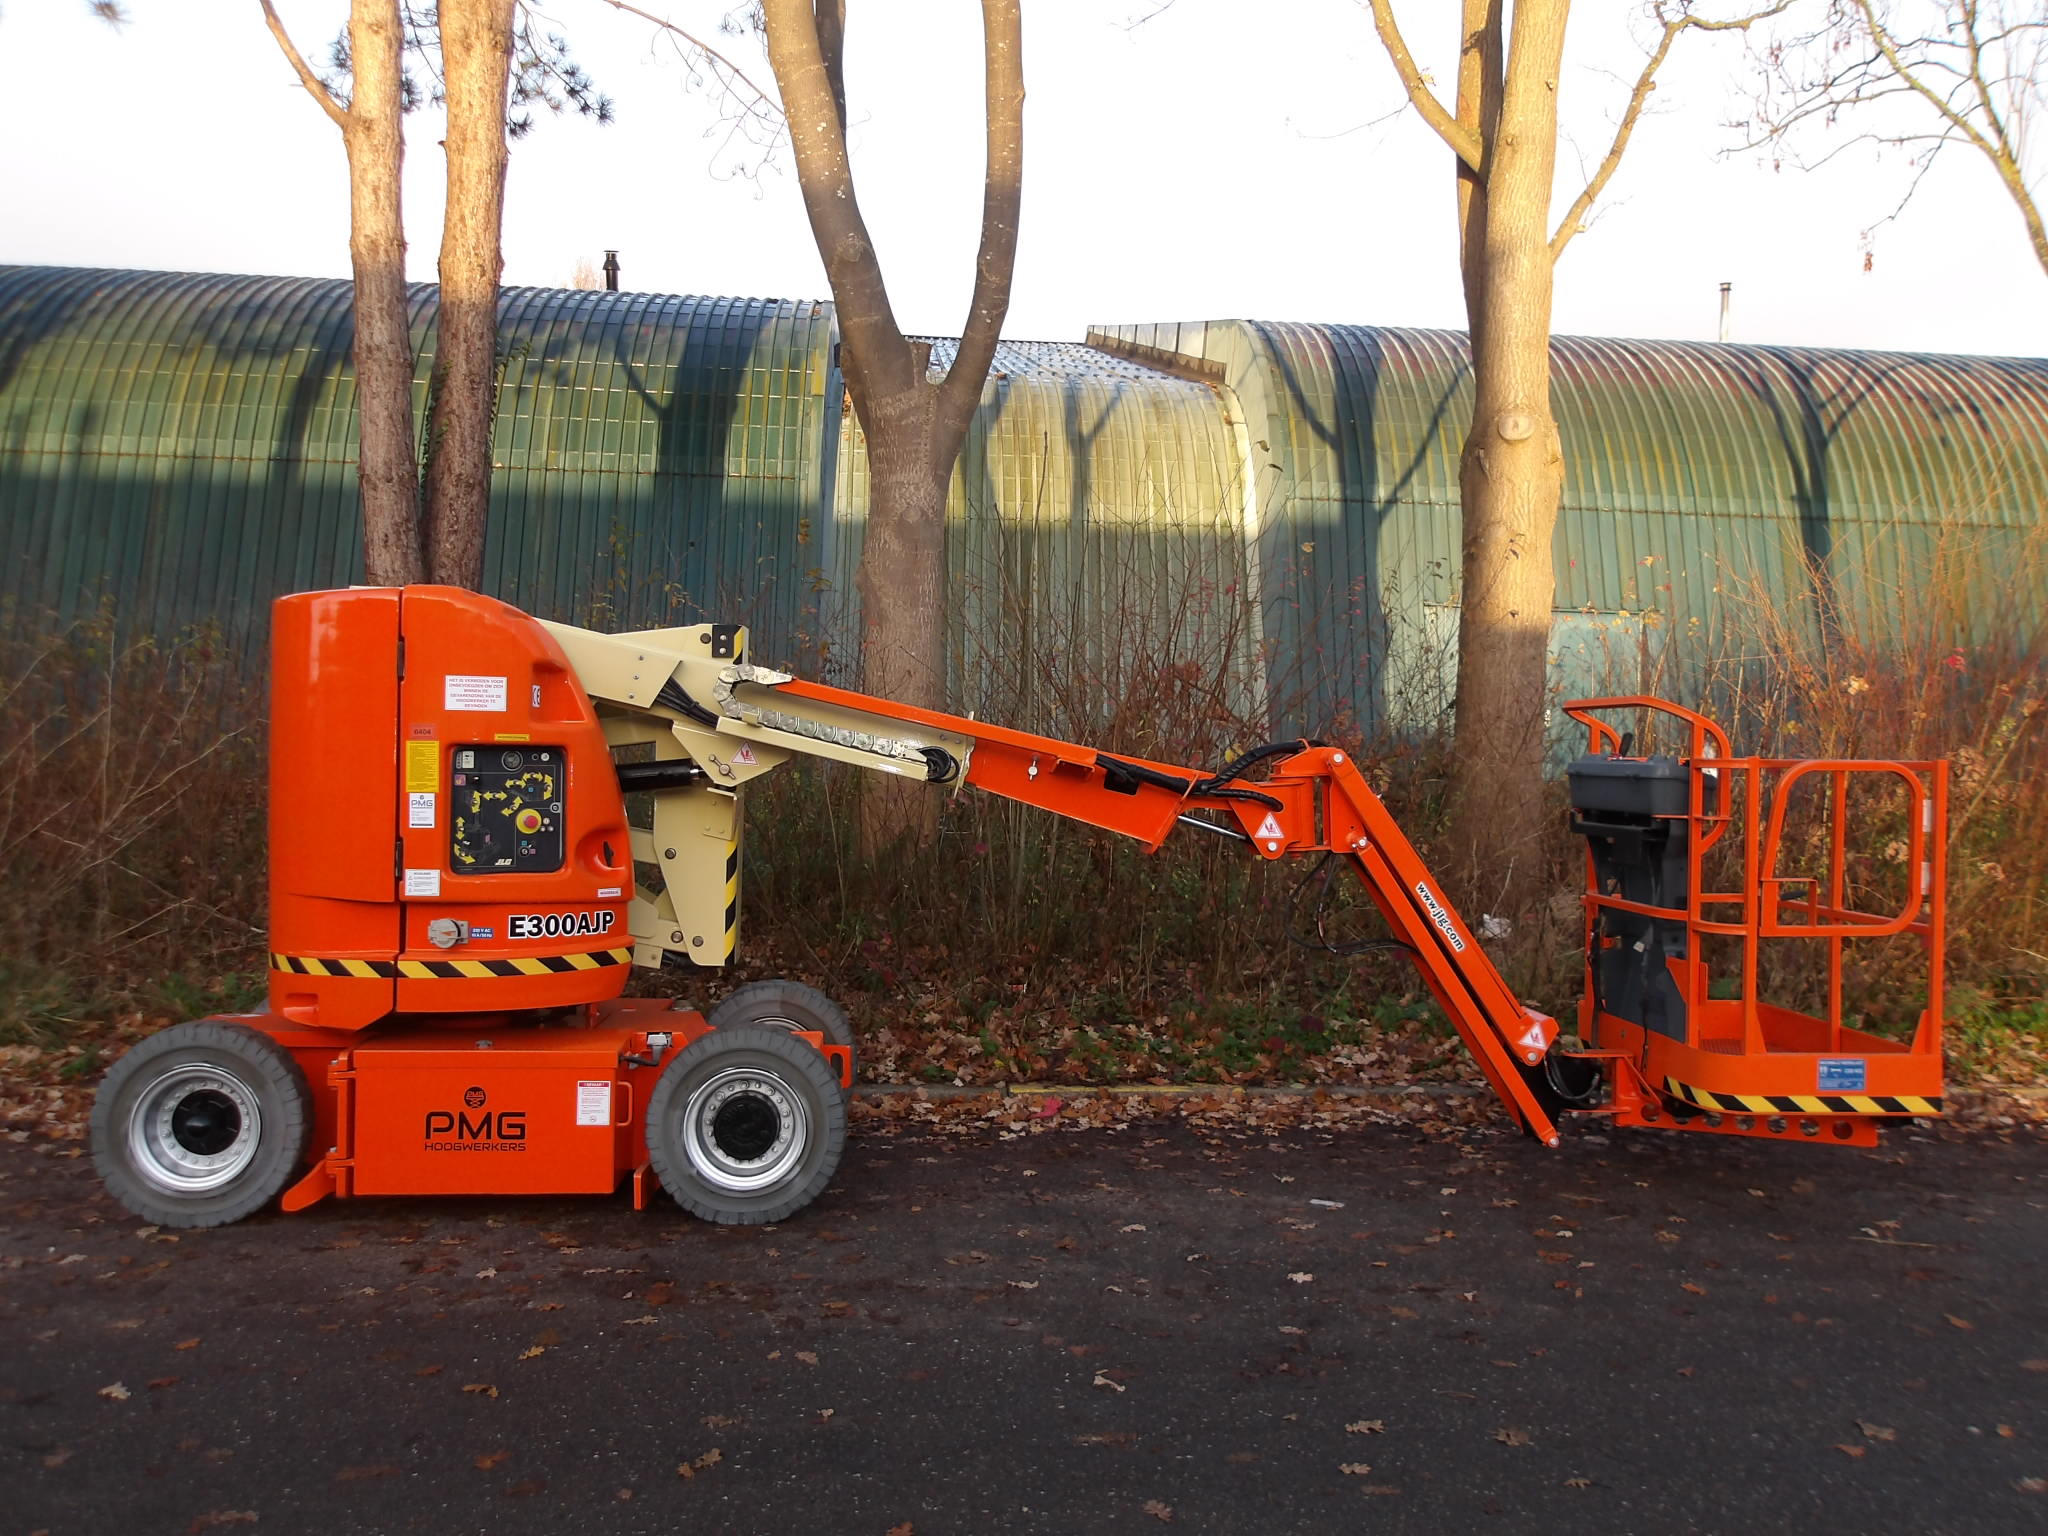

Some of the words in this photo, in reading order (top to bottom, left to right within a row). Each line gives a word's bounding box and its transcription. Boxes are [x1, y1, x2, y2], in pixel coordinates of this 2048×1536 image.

[411, 799, 433, 807] PMG
[509, 911, 614, 938] E300AJP
[1416, 883, 1464, 951] www.jlg.com
[425, 1111, 526, 1140] PMG
[425, 1142, 526, 1151] HOOGWERKERS
